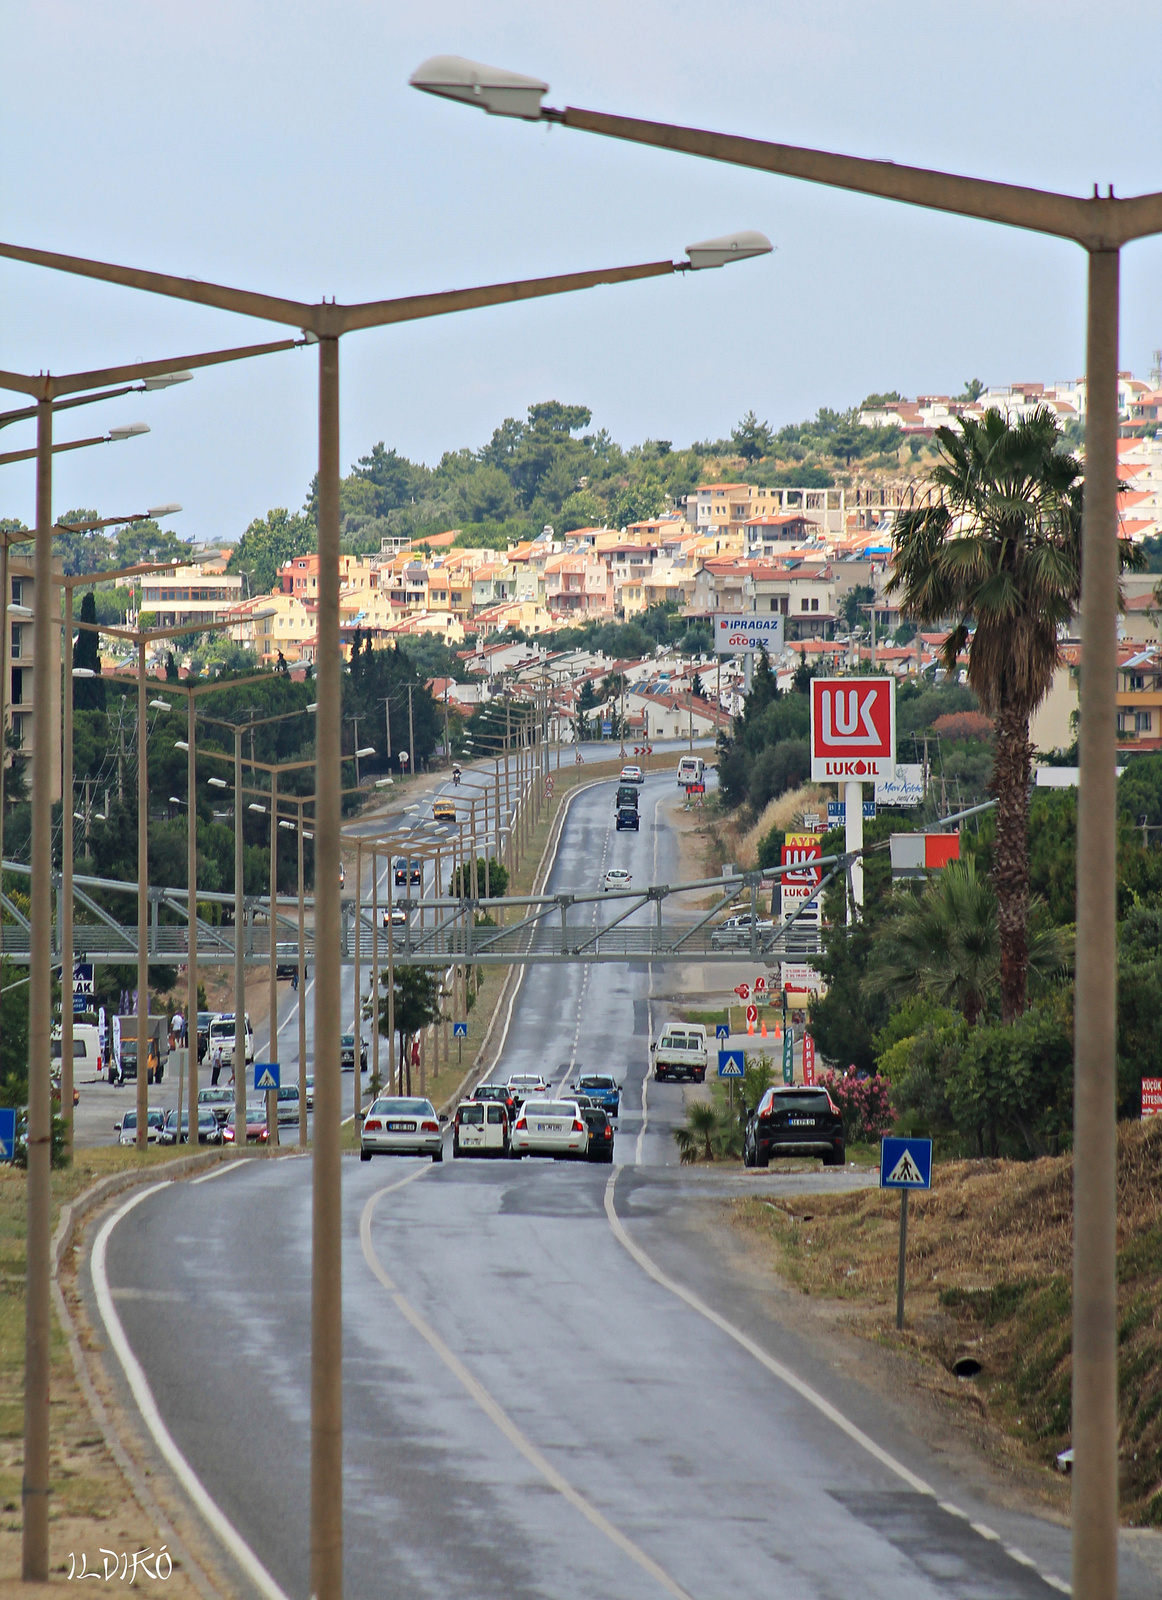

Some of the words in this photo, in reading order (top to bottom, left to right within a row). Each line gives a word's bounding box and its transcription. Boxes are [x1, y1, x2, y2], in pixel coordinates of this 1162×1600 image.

[729, 636, 769, 648] otogaz
[821, 690, 882, 746] LUK
[826, 759, 879, 775] LUKOIL
